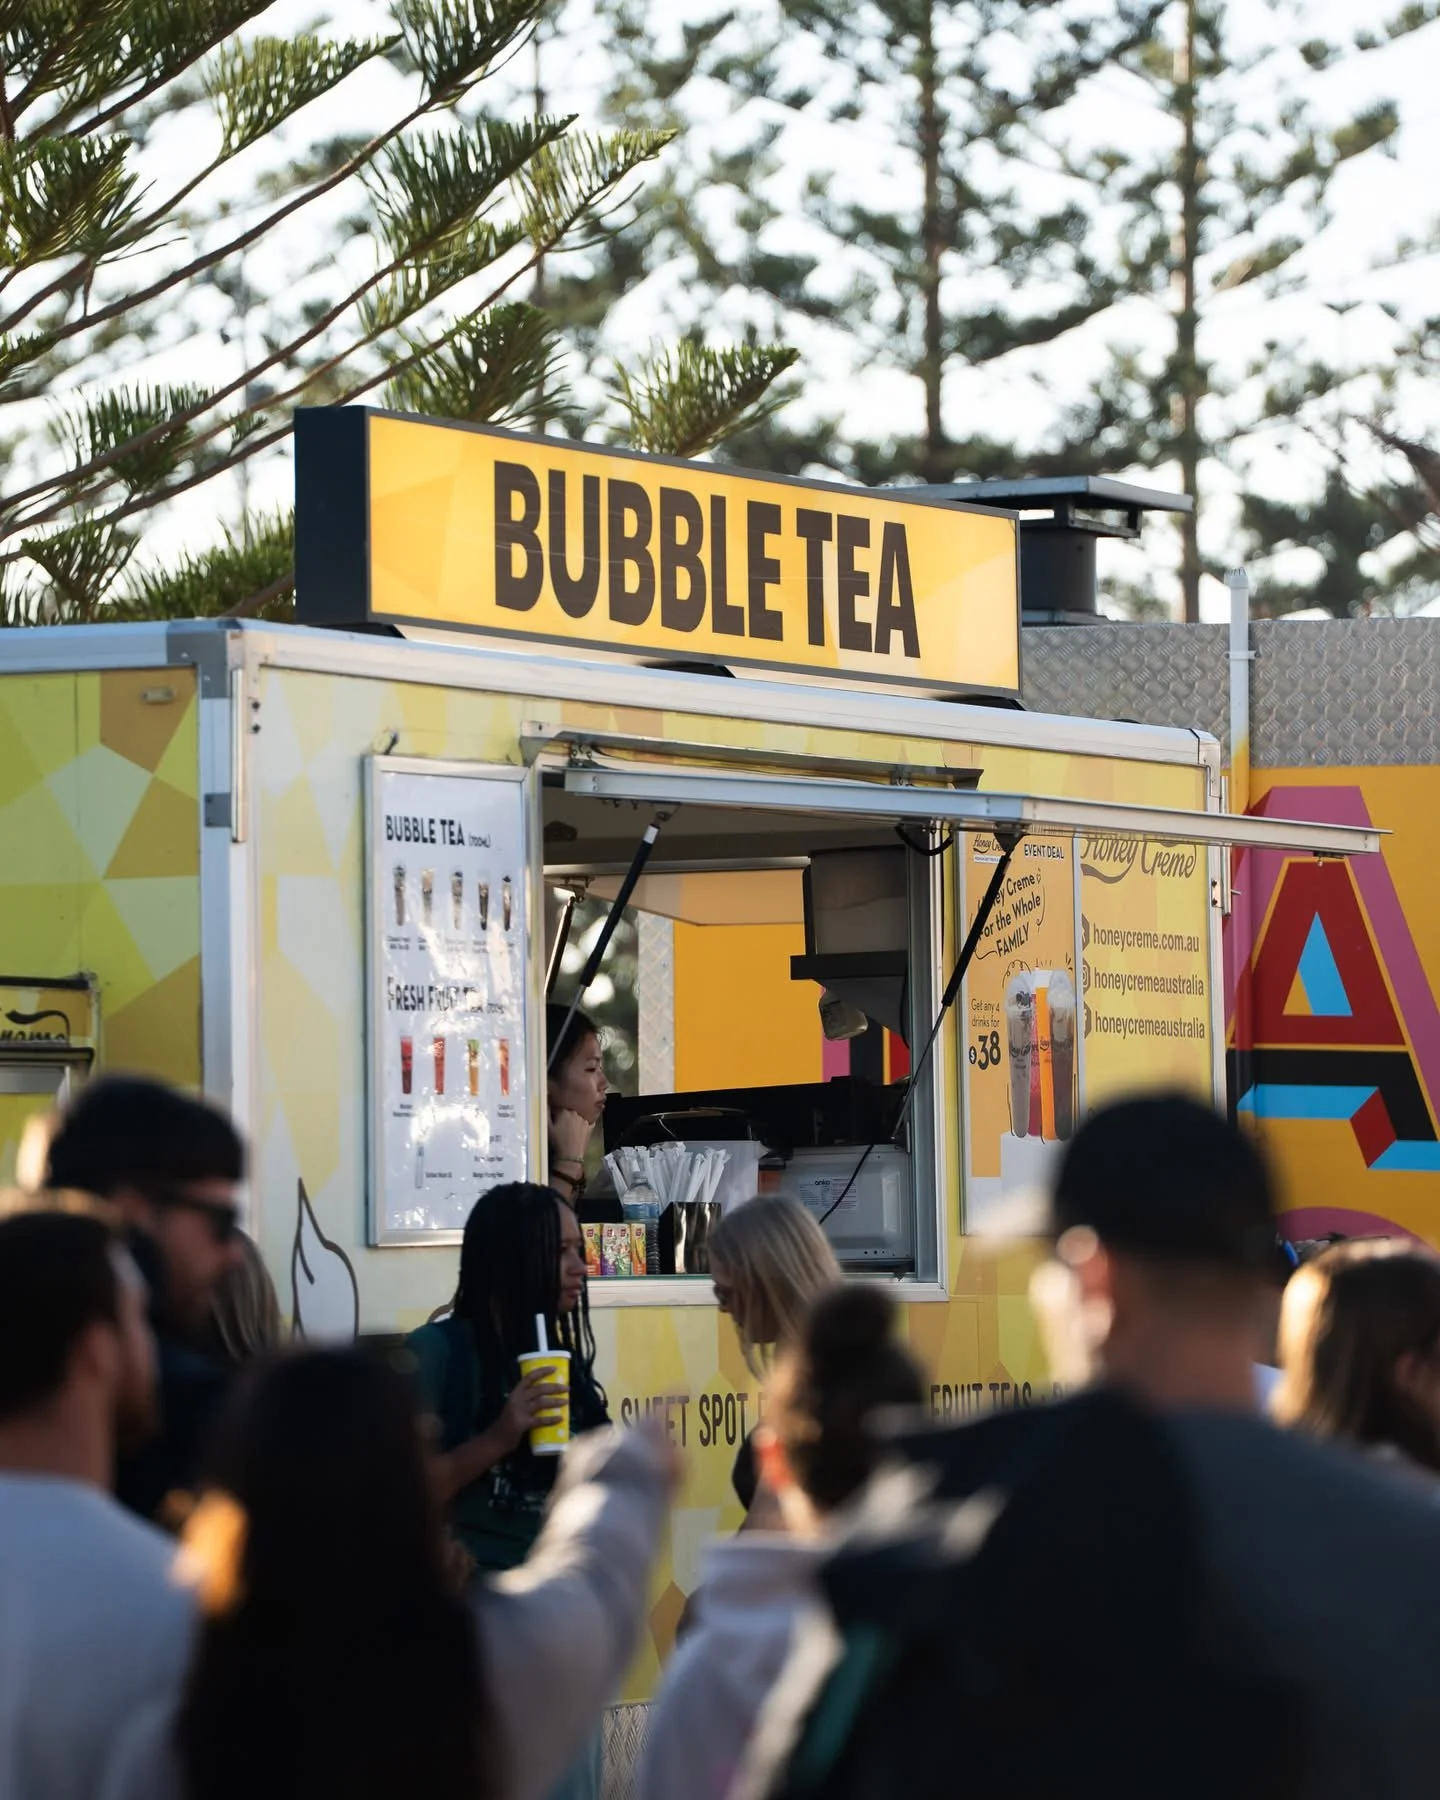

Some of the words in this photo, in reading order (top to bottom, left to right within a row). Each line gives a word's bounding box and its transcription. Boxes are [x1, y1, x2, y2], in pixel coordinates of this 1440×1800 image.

[494, 460, 784, 641] BUBBLE
[796, 507, 921, 658] TEA
[386, 815, 436, 844] BUBBLE
[440, 819, 465, 846] TEA
[1024, 844, 1046, 857] EVENT
[1047, 846, 1065, 859] DEAL
[1006, 874, 1036, 897] Creme
[996, 910, 1012, 931] the
[1012, 891, 1041, 920] Whole
[996, 922, 1029, 957] FAMILY
[1093, 922, 1200, 953] honeycreme.com.au
[1094, 967, 1205, 996] honeycremeaustralia
[970, 998, 983, 1011] Get
[984, 1002, 995, 1014] any
[971, 1014, 989, 1027] drinks
[990, 1014, 1000, 1028] for
[1095, 1010, 1206, 1040] honeycremeaustralia
[699, 1392, 748, 1447] SPOT
